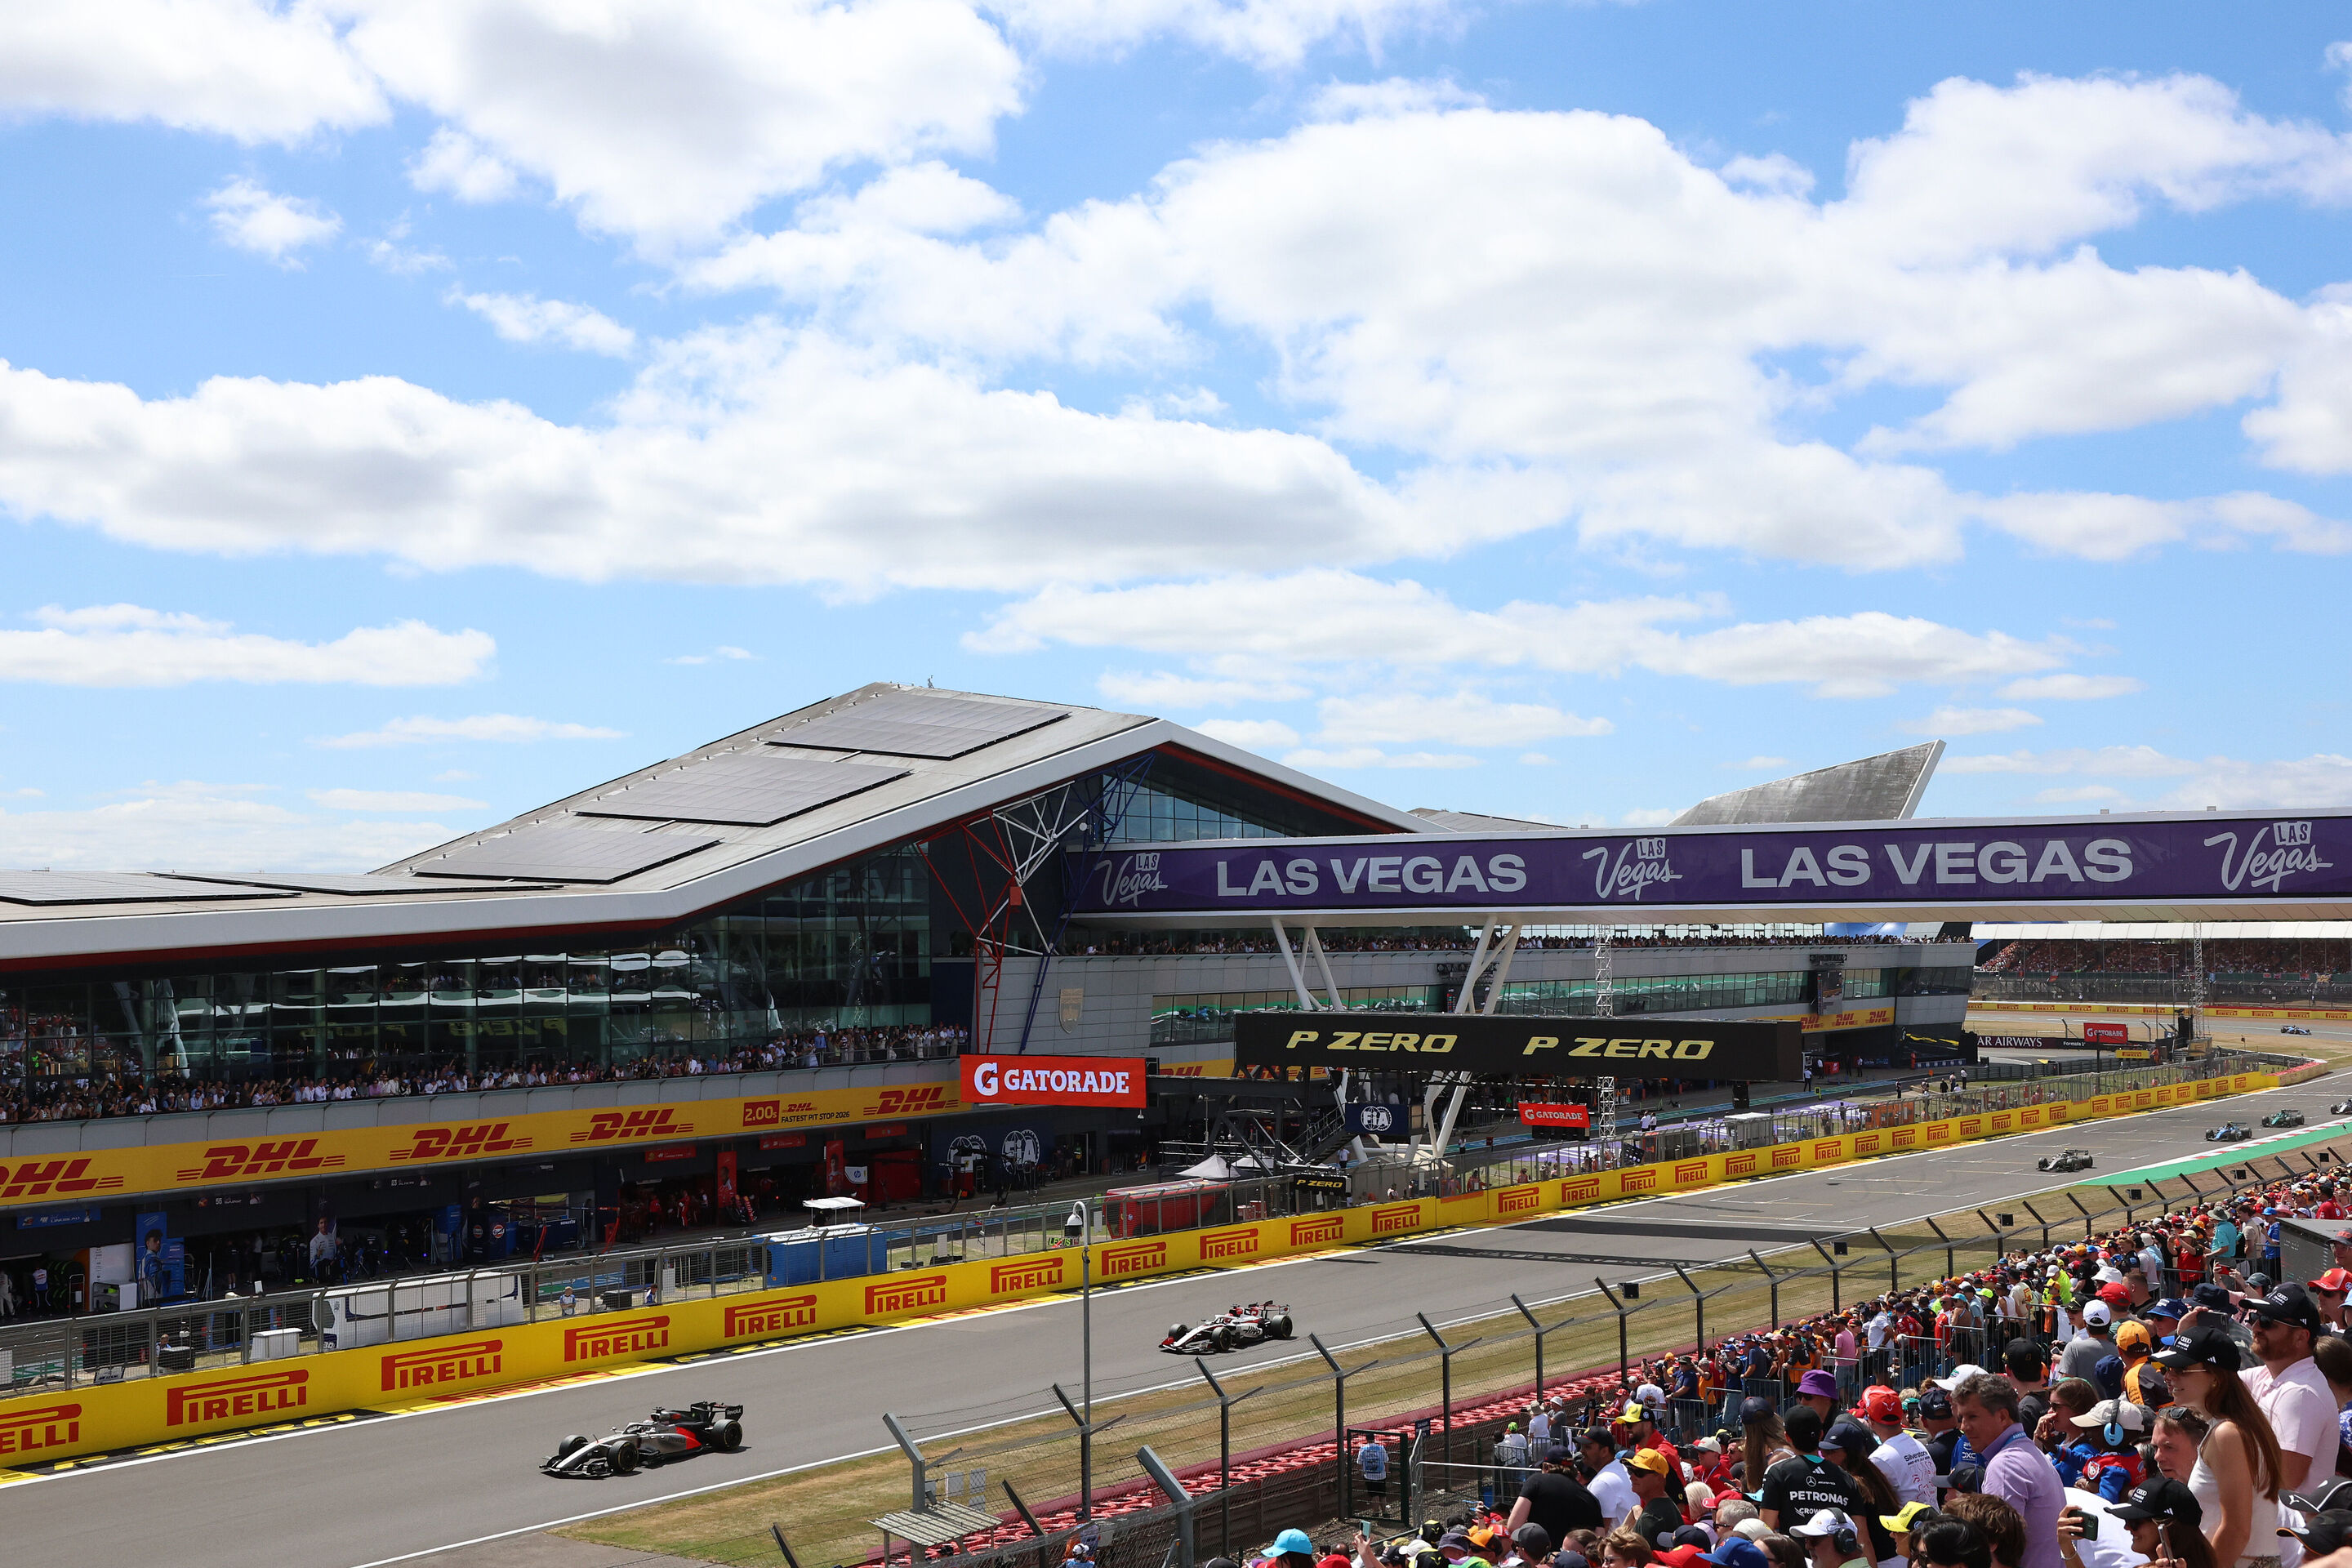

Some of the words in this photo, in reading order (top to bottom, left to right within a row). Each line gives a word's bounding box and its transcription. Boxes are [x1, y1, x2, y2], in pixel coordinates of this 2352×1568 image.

[2277, 822, 2309, 844] LAS
[1639, 839, 1664, 858] LAS
[2204, 826, 2333, 893] Vegas
[1138, 855, 1157, 870] LAS
[1583, 843, 1682, 901] Vegas
[1741, 845, 1870, 889] LAS
[1885, 839, 2133, 884] VEGAS
[1095, 856, 1168, 907] Vegas
[1218, 859, 1318, 897] LAS
[1330, 853, 1527, 894] VEGAS
[1286, 1031, 1319, 1049] P
[1327, 1031, 1458, 1053] ZERO
[1522, 1036, 1559, 1055] P
[1568, 1037, 1714, 1060] ZERO
[1995, 1037, 2042, 1047] AIRWAYS
[974, 1062, 998, 1096] G
[1004, 1069, 1129, 1094] GATORADE
[788, 1102, 813, 1112] DHL
[877, 1087, 947, 1114] DHL
[2092, 1099, 2108, 1113] PIRELLI
[2116, 1095, 2131, 1109] PIRELLI
[2136, 1093, 2151, 1106] PIRELLI
[745, 1106, 777, 1122] 2.00s
[781, 1115, 807, 1123] FASTEST
[1525, 1109, 1535, 1120] G
[1536, 1111, 1583, 1120] GATORADE
[1992, 1114, 2011, 1130] PIRELLI
[2021, 1109, 2039, 1125] PIRELLI
[2049, 1105, 2066, 1120] PIRELLI
[587, 1109, 678, 1140] DHL
[1927, 1124, 1949, 1141] PIRELLI
[1960, 1119, 1980, 1135] PIRELLI
[410, 1123, 514, 1158] DHL
[1855, 1134, 1879, 1153] PIRELLI
[1892, 1129, 1915, 1147] PIRELLI
[201, 1139, 323, 1178] DHL
[1772, 1147, 1800, 1167] PIRELLI
[1815, 1140, 1841, 1160] PIRELLI
[1675, 1161, 1708, 1183] PIRELLI
[1726, 1154, 1756, 1175] PIRELLI
[1561, 1178, 1600, 1202] PIRELLI
[1621, 1169, 1656, 1192] PIRELLI
[1498, 1187, 1539, 1214] PIRELLI
[1372, 1205, 1420, 1233] PIRELLI
[1290, 1216, 1343, 1246] PIRELLI
[1200, 1227, 1258, 1260] PIRELLI
[1102, 1241, 1166, 1276] PIRELLI
[991, 1257, 1063, 1294] PIRELLI
[865, 1275, 947, 1315] PIRELLI
[724, 1294, 817, 1338] PIRELLI
[564, 1316, 670, 1361] PIRELLI
[381, 1339, 503, 1392] PIRELLI
[167, 1370, 310, 1426] PIRELLI
[0, 1403, 82, 1454] ELLI
[1962, 1451, 1976, 1459] DXC
[1789, 1490, 1849, 1506] PETRONAS
